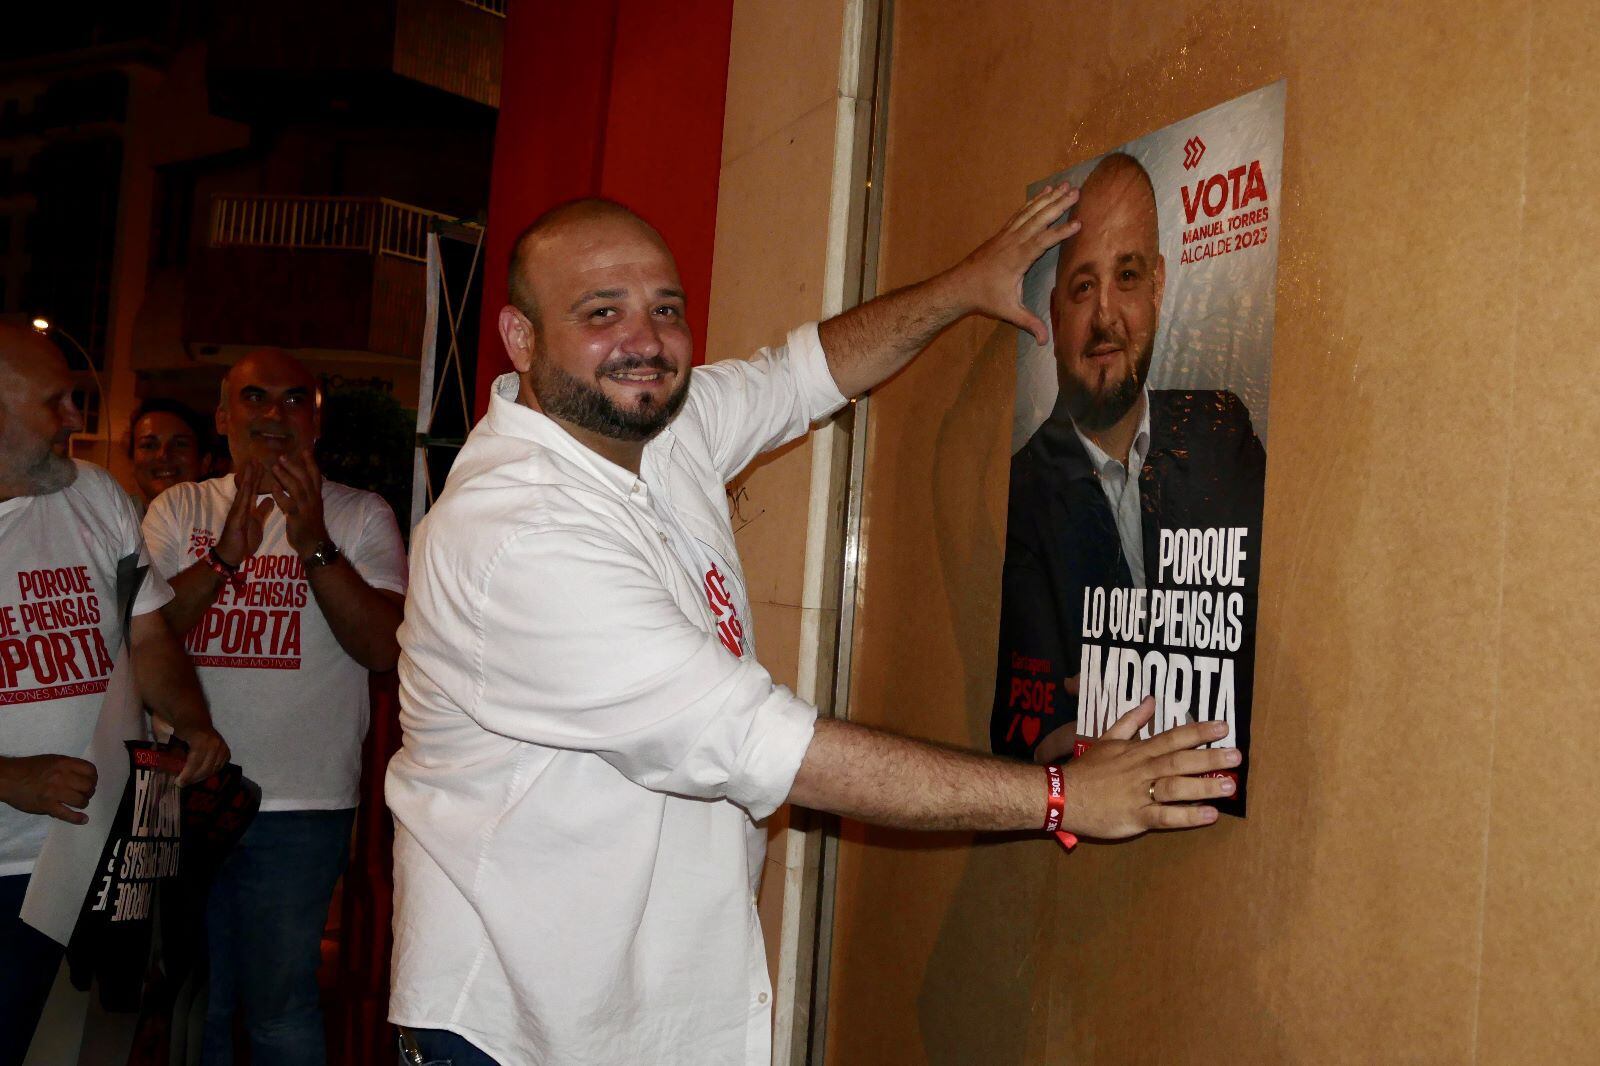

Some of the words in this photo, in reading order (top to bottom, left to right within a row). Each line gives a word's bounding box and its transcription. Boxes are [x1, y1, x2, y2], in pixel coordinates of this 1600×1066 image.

[1181, 160, 1267, 224] VOTA
[1182, 221, 1225, 245] MANUEL
[1228, 206, 1269, 231] TORRES
[1180, 237, 1232, 265] ALCALDE
[1234, 226, 1268, 251] 2023
[1158, 527, 1248, 587] PORQUE
[18, 566, 95, 600] PORQUE
[232, 581, 307, 608] PIENSAS
[19, 595, 101, 633] PIENSAS
[1082, 586, 1105, 639] LO
[1109, 587, 1147, 643] QUE
[1149, 589, 1244, 652] PIENSAS
[54, 685, 75, 698] MIS
[1008, 676, 1057, 716] PSOE
[1075, 644, 1237, 750] IMPORTA
[1051, 776, 1061, 798] PSOE
